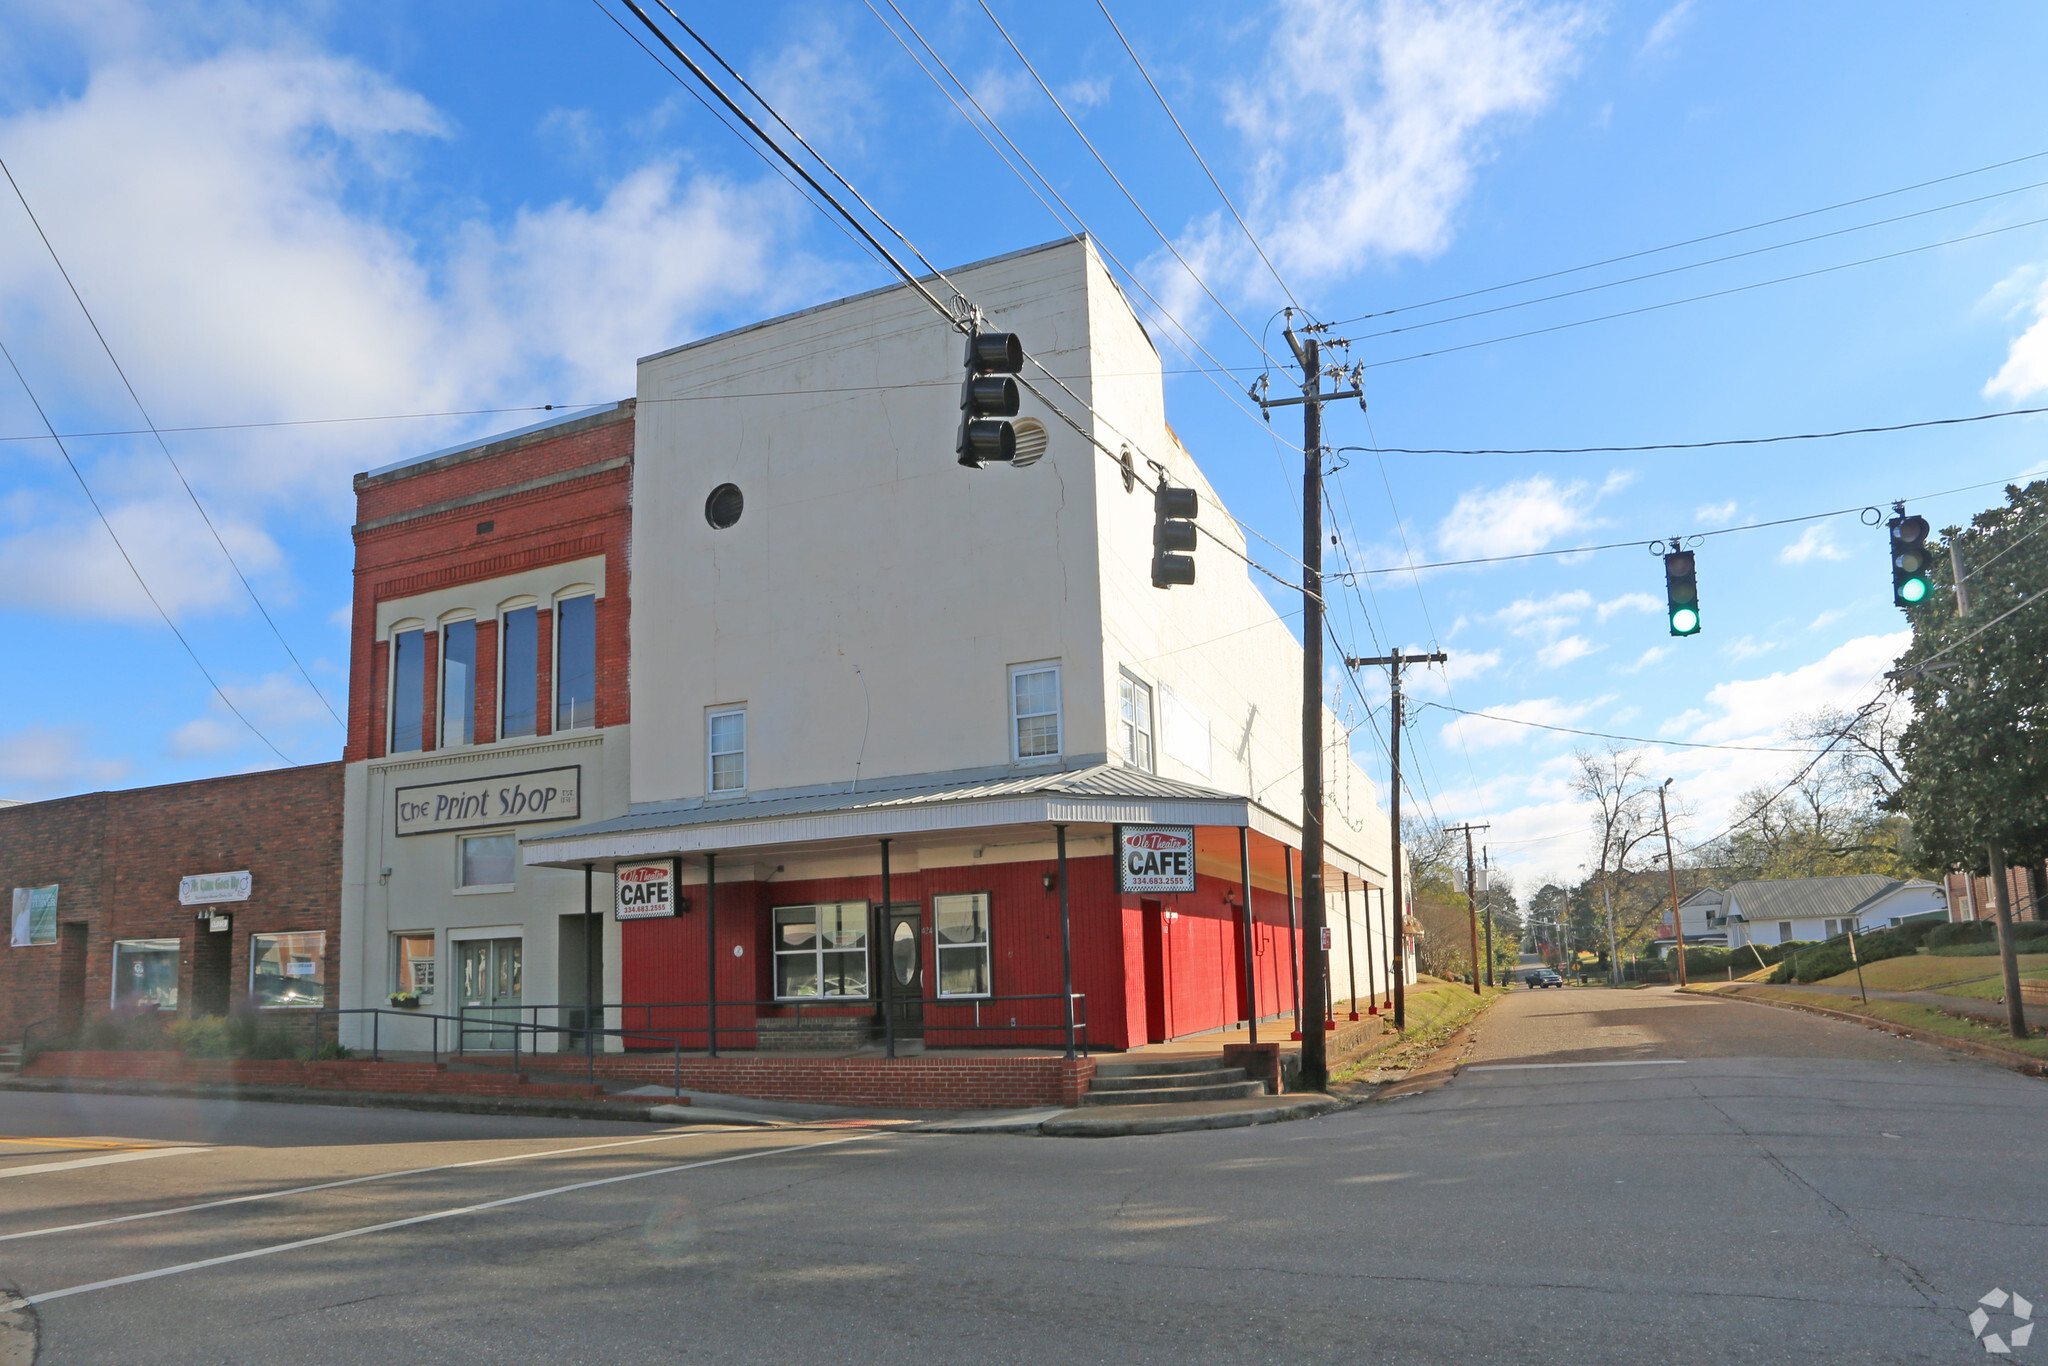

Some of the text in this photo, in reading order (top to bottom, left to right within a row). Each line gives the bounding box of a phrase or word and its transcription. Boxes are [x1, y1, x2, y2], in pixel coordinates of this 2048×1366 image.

[400, 801, 430, 822] The
[434, 788, 490, 821] Print
[1131, 833, 1183, 849] Ole Theater
[1127, 850, 1188, 876] CAFE
[623, 869, 639, 883] Ole
[1132, 877, 1184, 885] 334.683.2555
[620, 882, 669, 905] CAFE
[624, 904, 666, 913] 334.683.2555
